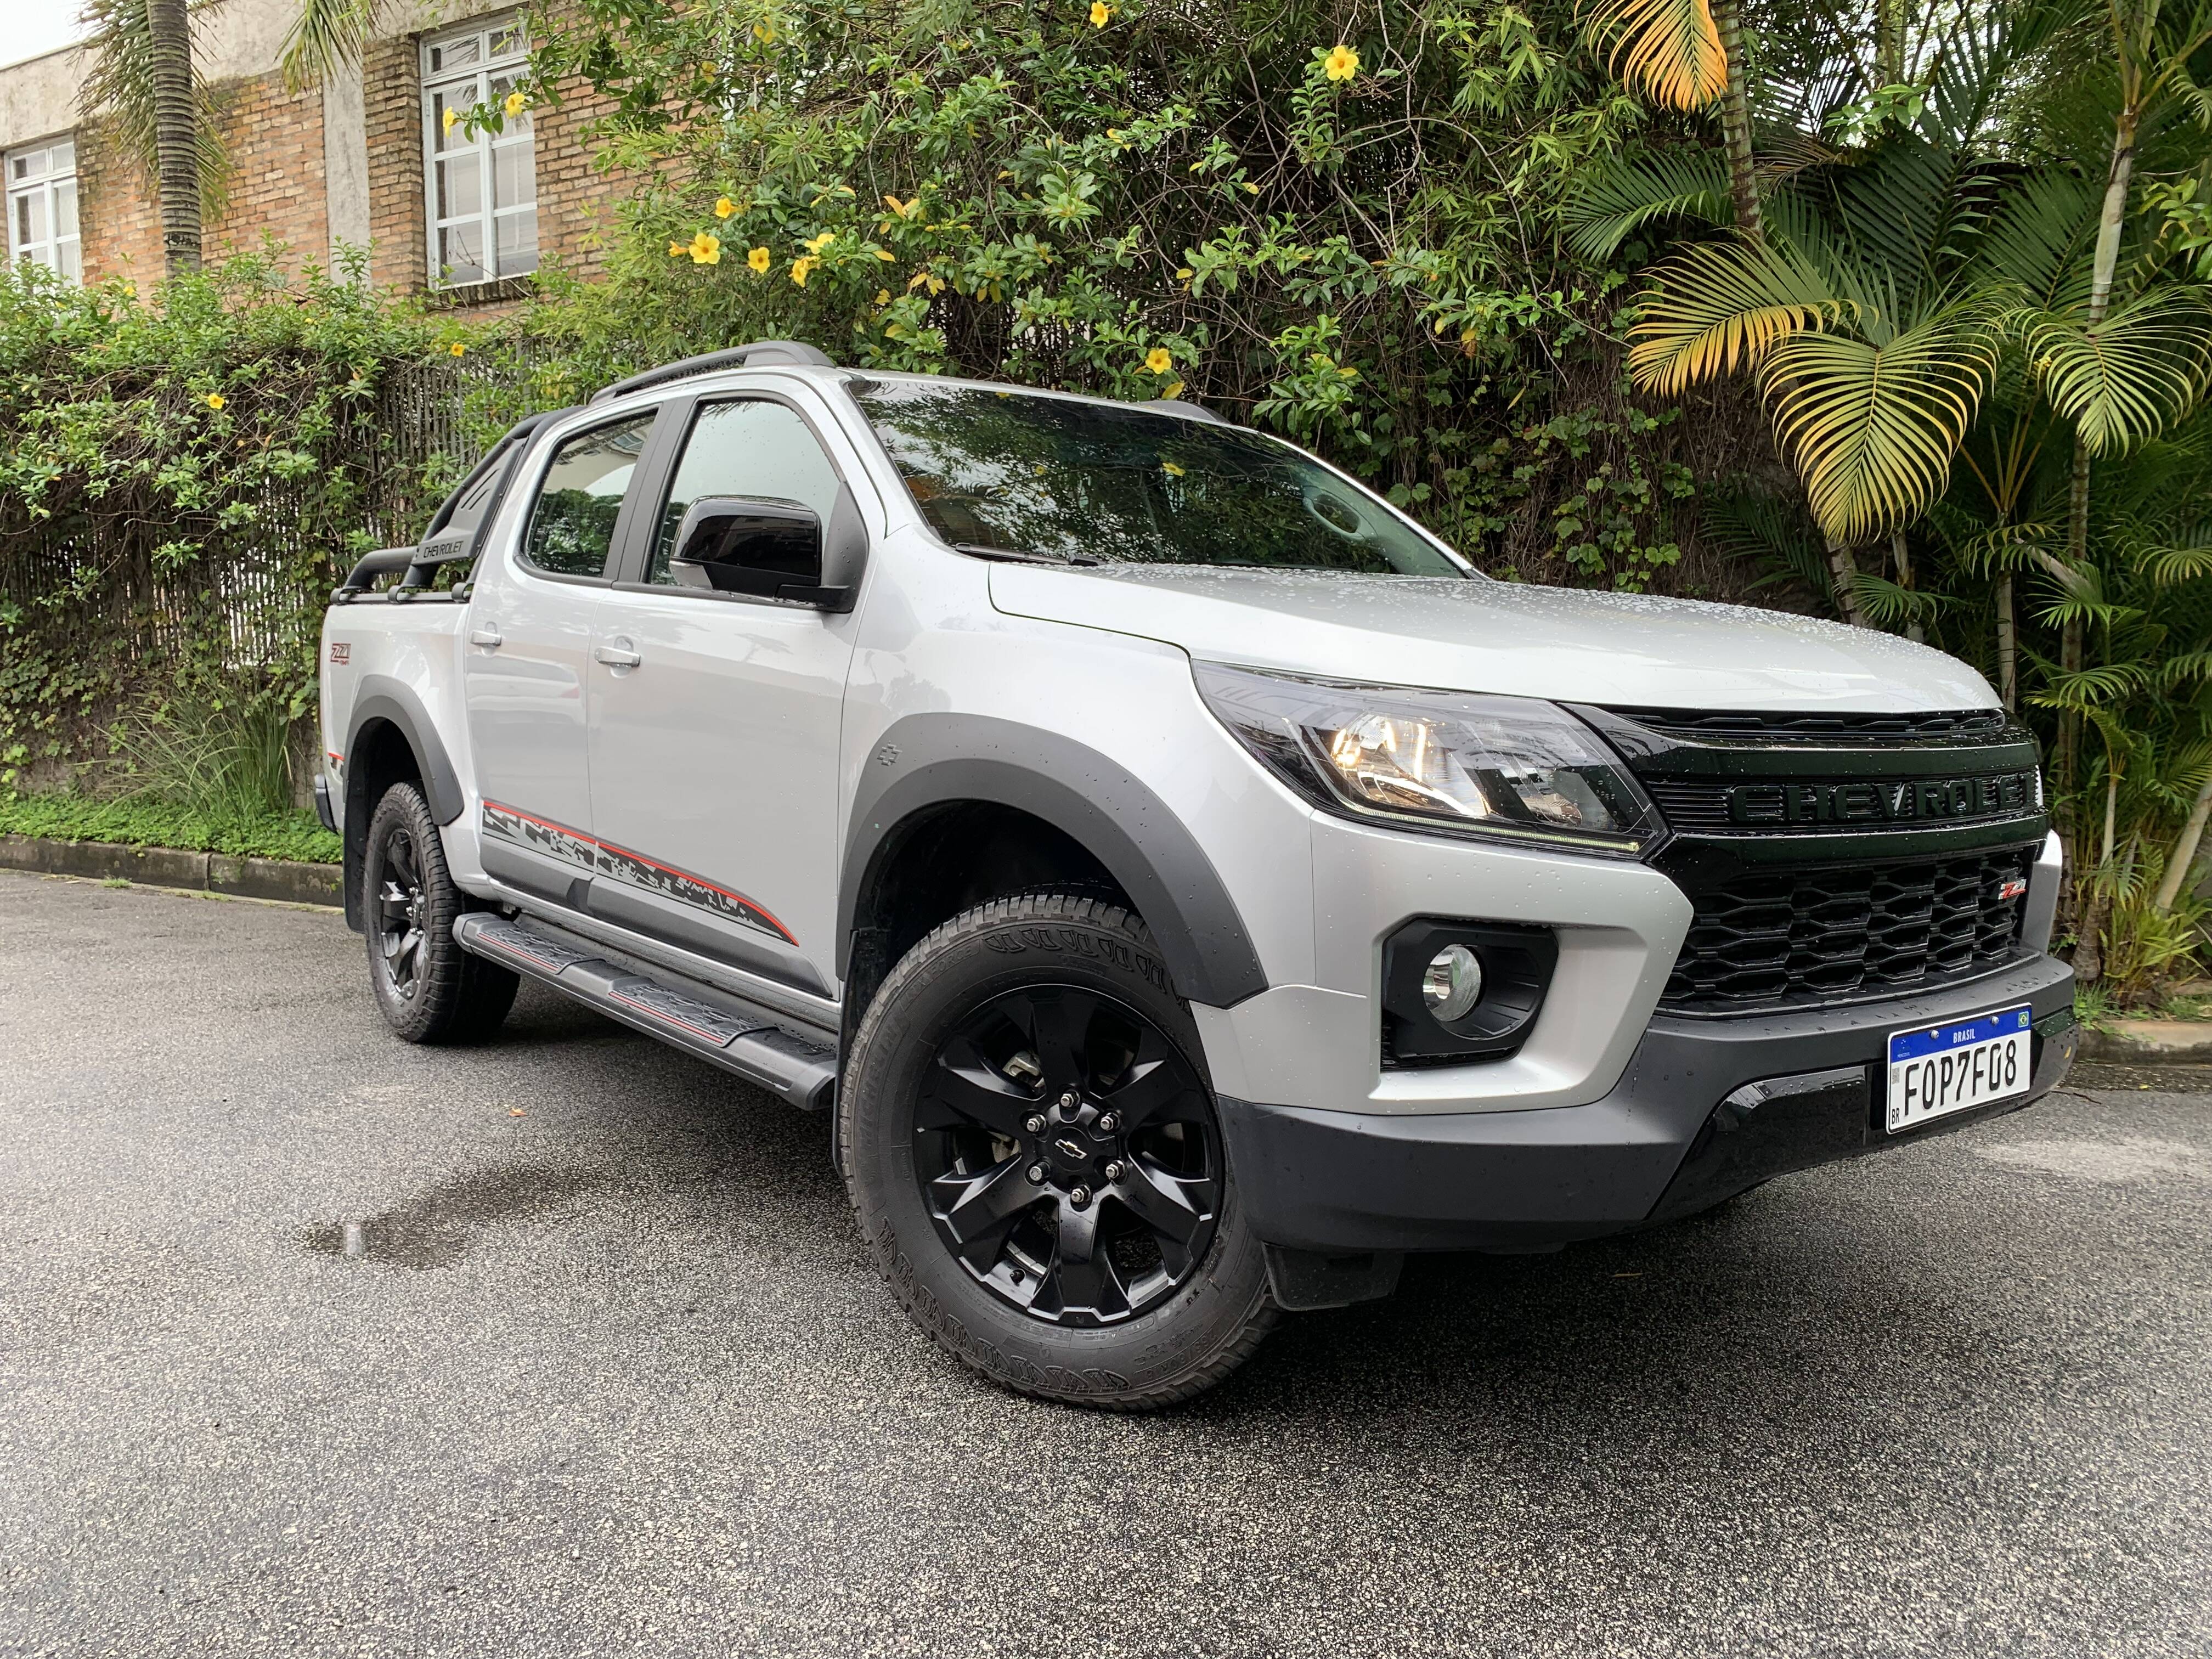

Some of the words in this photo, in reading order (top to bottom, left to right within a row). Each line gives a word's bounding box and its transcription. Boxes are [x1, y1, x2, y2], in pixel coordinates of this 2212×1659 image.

[424, 541, 464, 557] CHEVROLET
[1730, 772, 2033, 821] CHEVROLET
[1953, 1028, 1975, 1044] BRASIL
[1905, 1039, 2017, 1116] FOP7F08
[1892, 1108, 1900, 1125] BR
